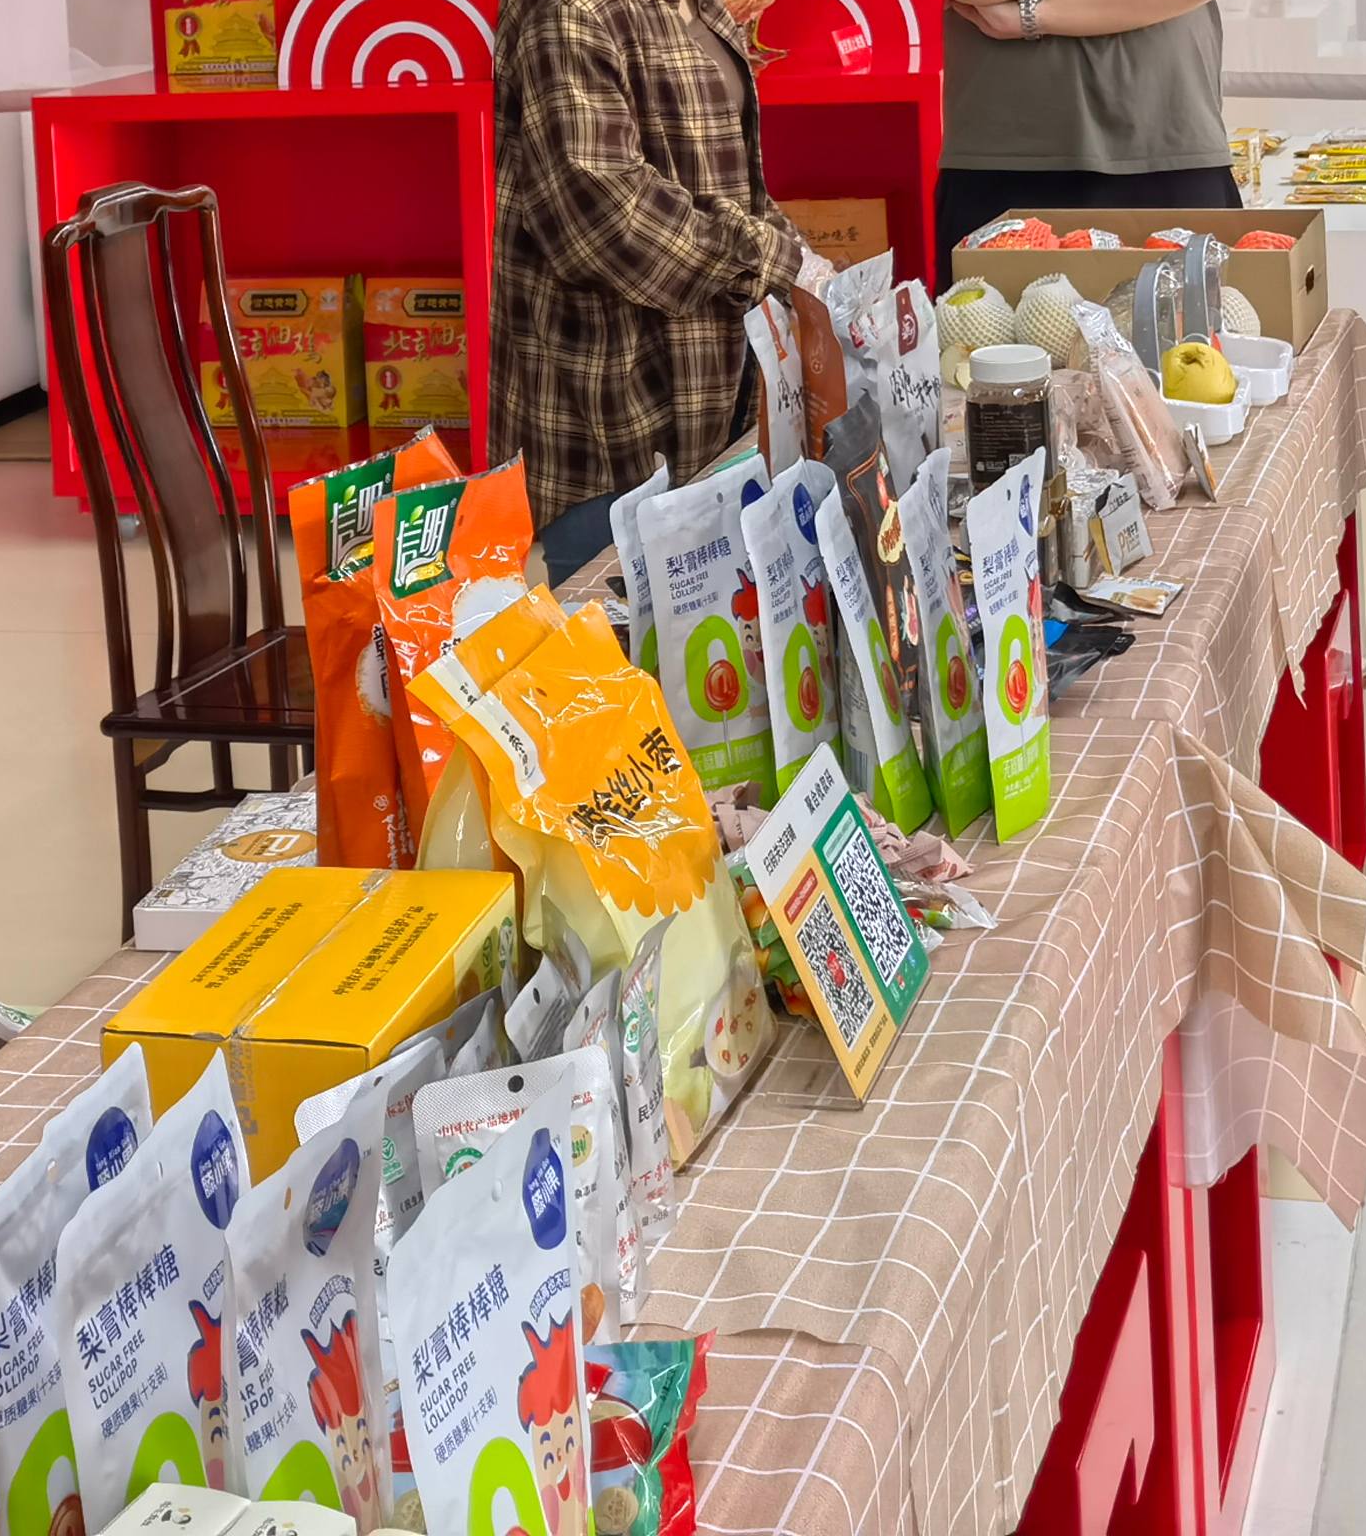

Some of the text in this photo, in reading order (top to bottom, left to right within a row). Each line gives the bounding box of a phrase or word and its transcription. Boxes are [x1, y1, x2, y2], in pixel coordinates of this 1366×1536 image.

[438, 1107, 527, 1137] 中国农产品地理
[76, 1242, 181, 1370] 梨膏棒棒糖
[412, 1263, 510, 1395] 梨膏棒棒糖
[88, 1328, 145, 1394] SUGAR FREE
[92, 1357, 138, 1411] LOLLIPOP
[420, 1350, 477, 1418] SUGAR FREE
[424, 1380, 469, 1436] LOLLIPOP
